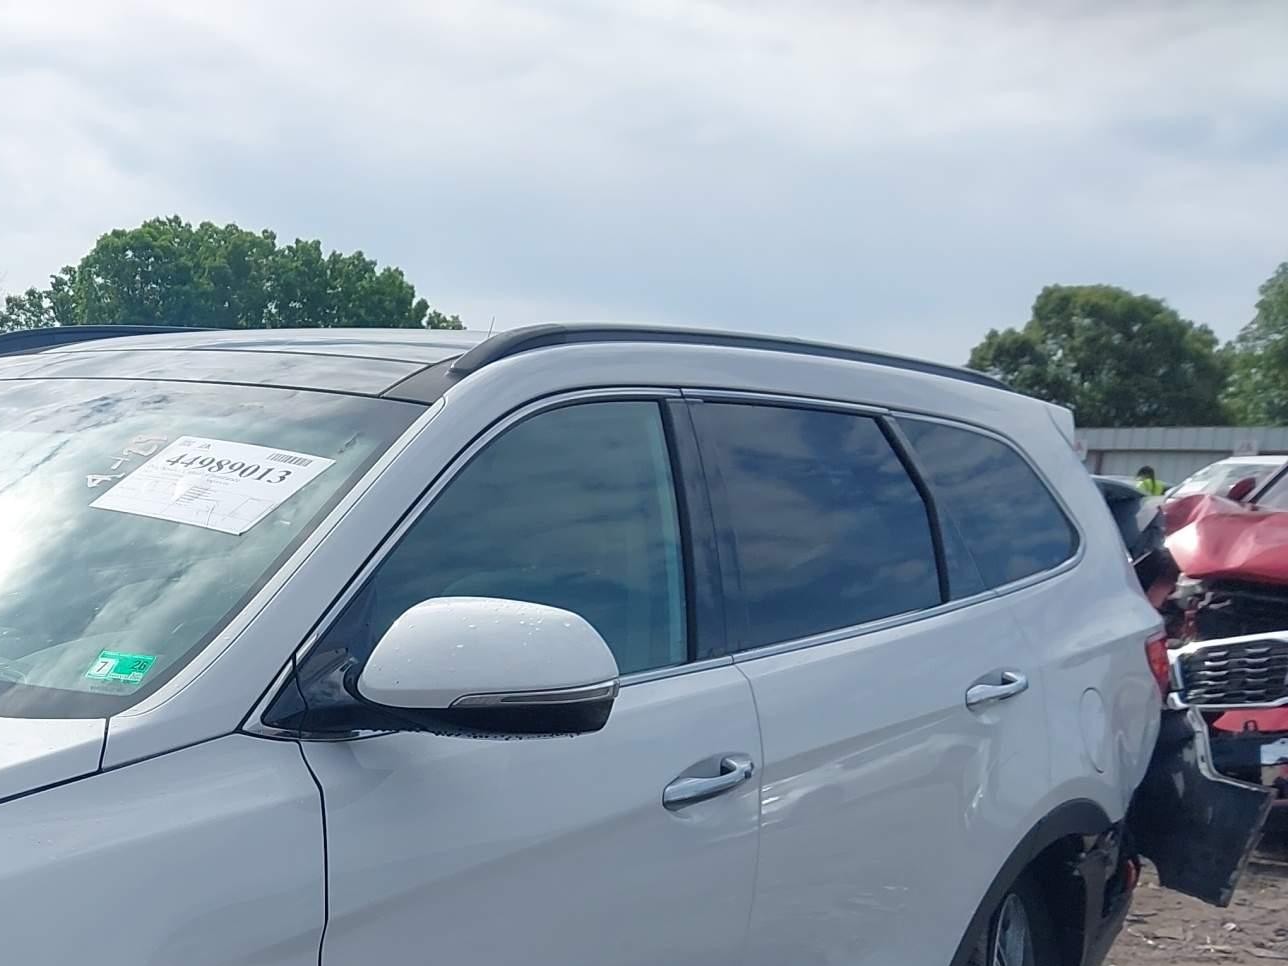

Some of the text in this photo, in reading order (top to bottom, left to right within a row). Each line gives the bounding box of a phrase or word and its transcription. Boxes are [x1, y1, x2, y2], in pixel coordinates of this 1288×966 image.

[166, 453, 292, 484] 44989013
[96, 660, 148, 672] 7 26
